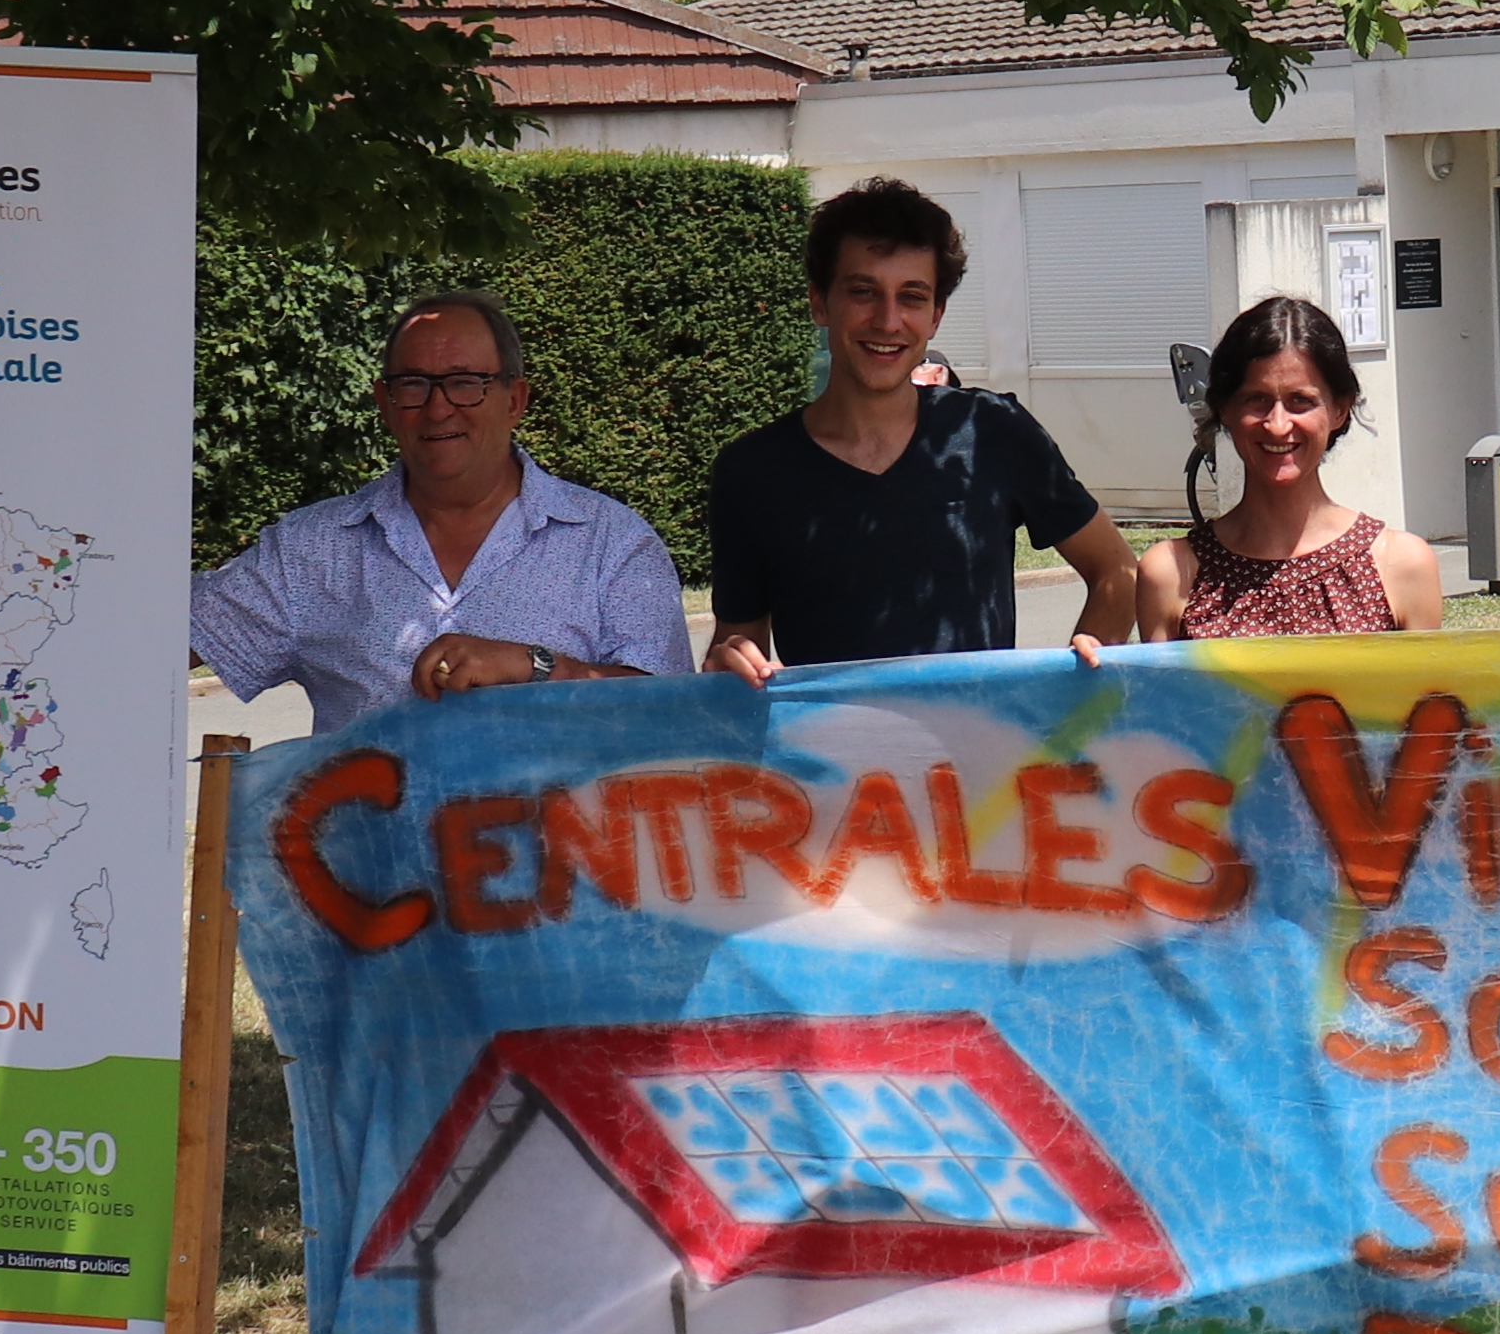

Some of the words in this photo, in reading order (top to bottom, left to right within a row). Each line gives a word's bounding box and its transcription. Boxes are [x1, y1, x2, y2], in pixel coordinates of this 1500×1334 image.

[270, 746, 1257, 953] CENTRALES
[22, 1127, 117, 1176] 350
[1, 1215, 77, 1232] SERVICE
[8, 1253, 77, 1271] bâtiments
[80, 1258, 129, 1275] publics
